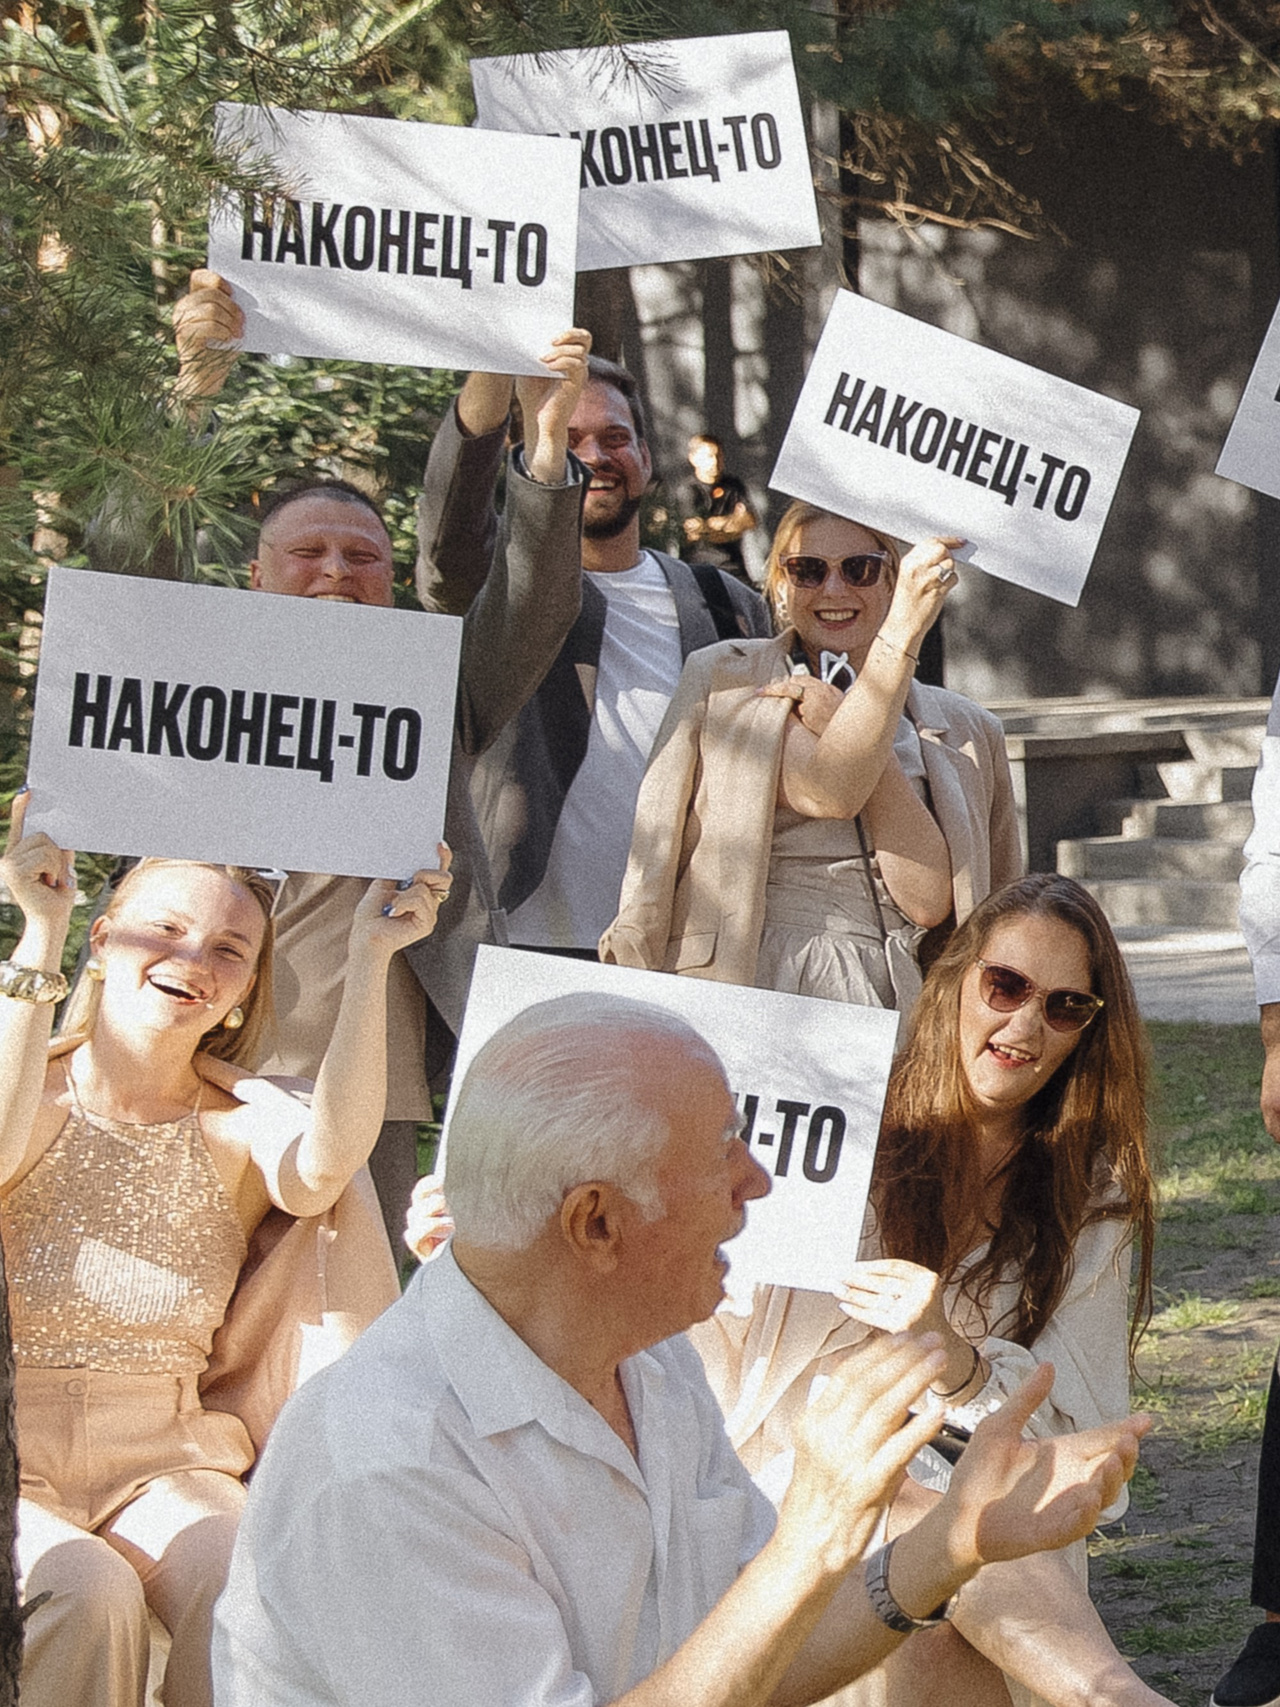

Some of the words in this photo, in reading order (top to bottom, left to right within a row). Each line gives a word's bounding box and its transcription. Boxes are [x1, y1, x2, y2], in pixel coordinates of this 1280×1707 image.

[547, 112, 782, 189] КОНЕЦ-ТО
[241, 197, 548, 290] НАКОНЕЦ-ТО
[823, 371, 1092, 522] НАКОНЕЦ-ТО
[68, 671, 422, 783] НАКОНЕЦ-ТО
